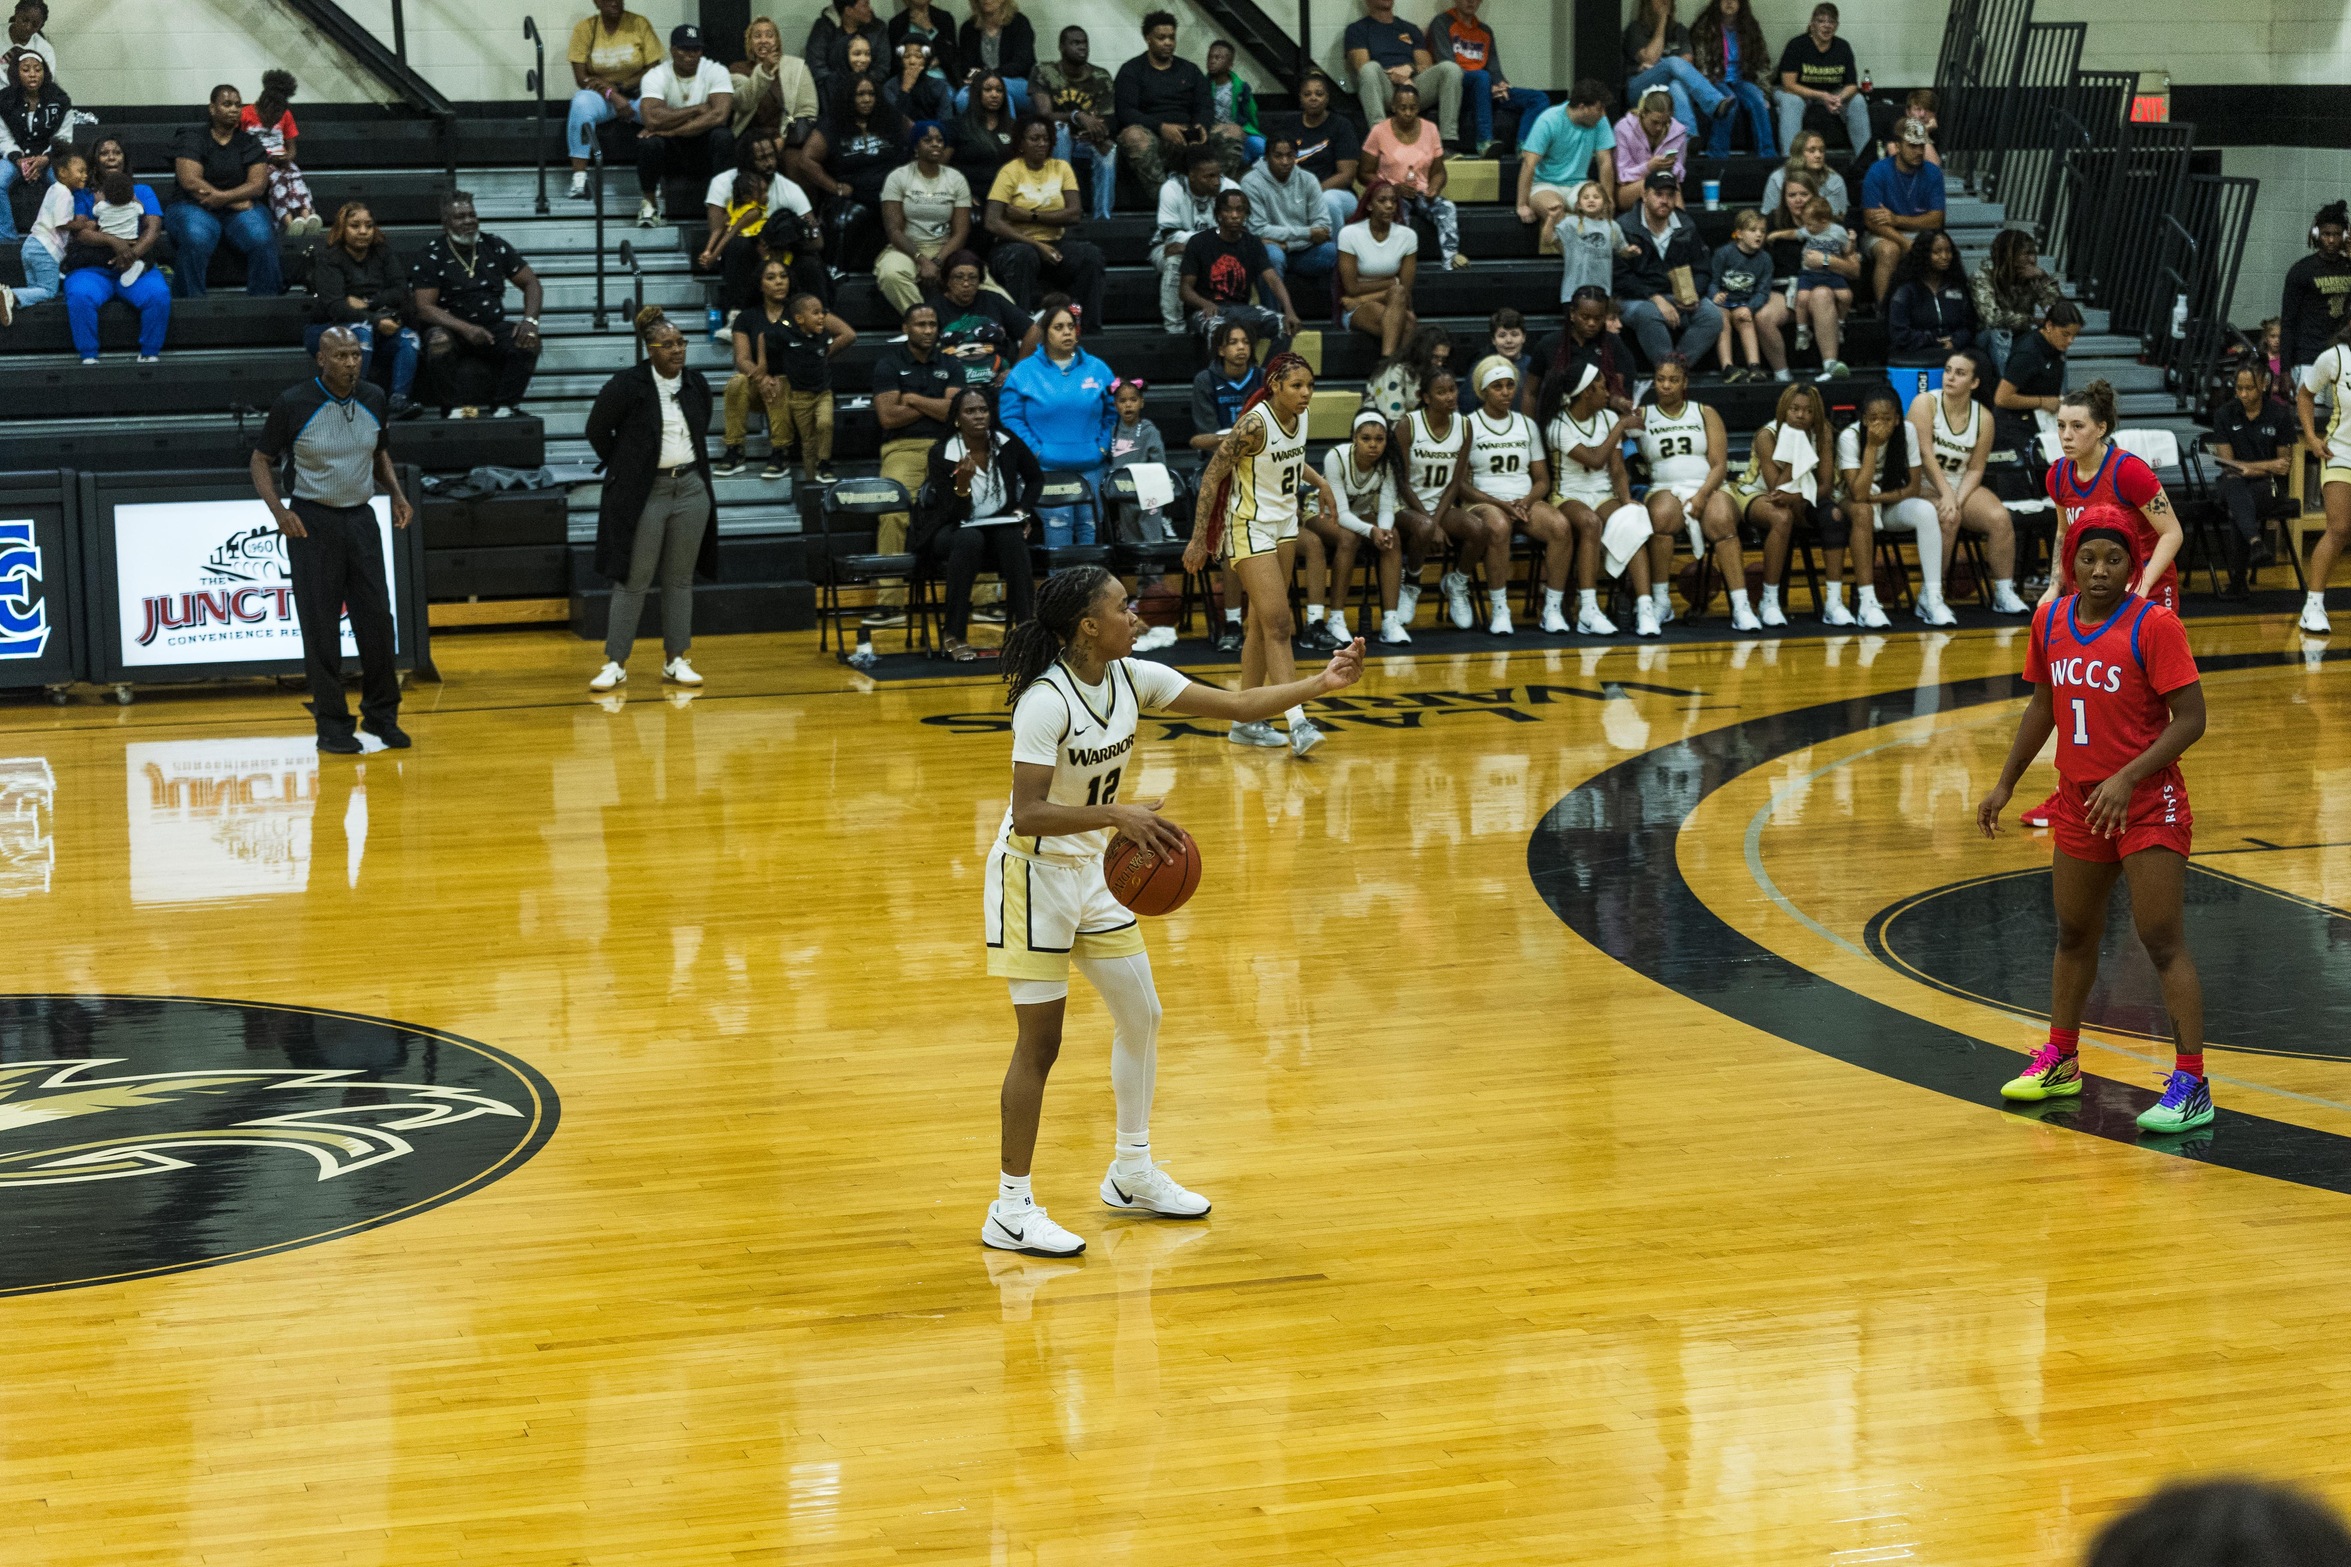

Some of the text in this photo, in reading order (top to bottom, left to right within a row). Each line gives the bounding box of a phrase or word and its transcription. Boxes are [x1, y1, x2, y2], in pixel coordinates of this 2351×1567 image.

[1476, 440, 1527, 451] WARRIORS
[1659, 436, 1693, 459] 23
[1490, 454, 1519, 474] 20
[1281, 463, 1302, 496] 21
[1423, 465, 1448, 488] 10
[200, 577, 227, 586] THE
[167, 629, 275, 647] CONVENIENCE
[2051, 657, 2122, 694] WCCS
[2071, 697, 2090, 746] 1
[1086, 767, 1122, 806] 12
